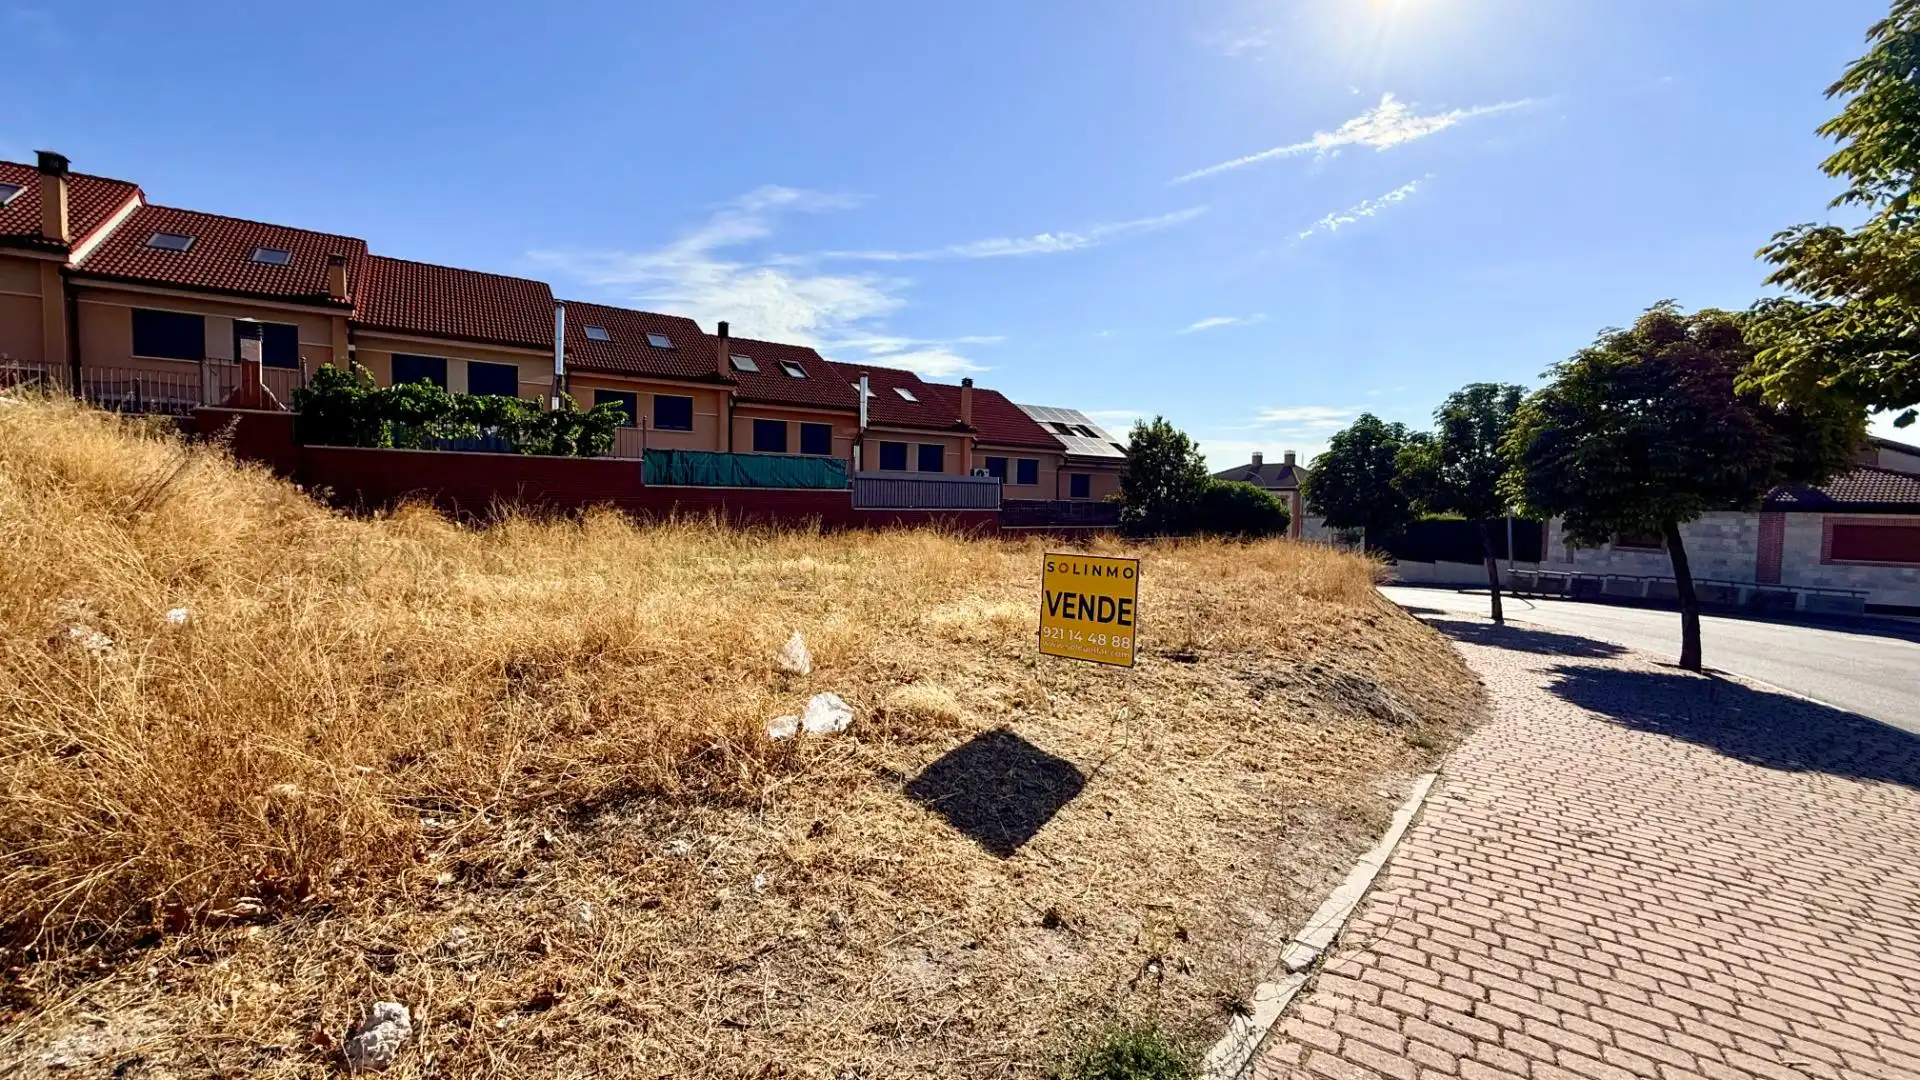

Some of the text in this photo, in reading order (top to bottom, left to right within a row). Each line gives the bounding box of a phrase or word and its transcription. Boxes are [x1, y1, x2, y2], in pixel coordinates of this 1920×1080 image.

[1047, 562, 1134, 579] SOLINMO
[1045, 590, 1133, 626] VENDE
[1043, 626, 1130, 649] 921 14 48 88
